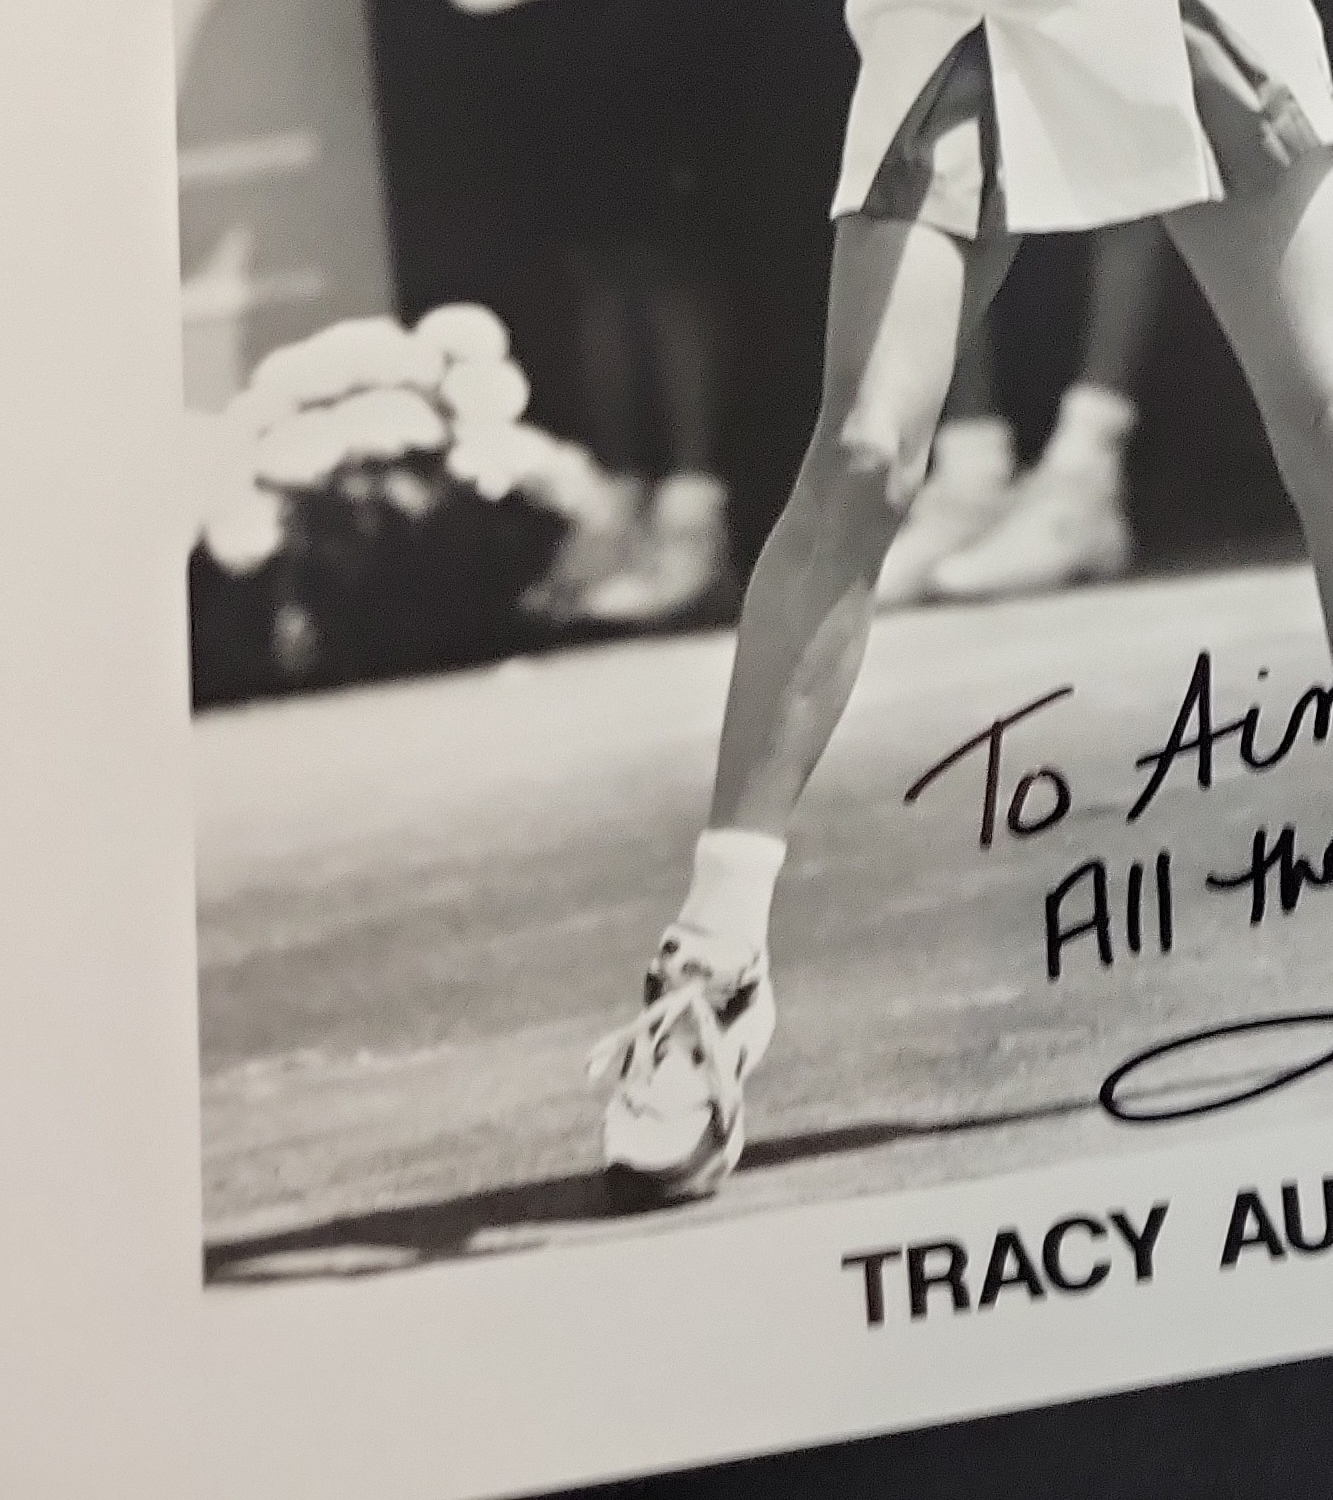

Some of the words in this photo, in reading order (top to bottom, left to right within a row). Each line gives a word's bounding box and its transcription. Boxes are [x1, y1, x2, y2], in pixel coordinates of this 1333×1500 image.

[904, 686, 1073, 848] To
[1044, 850, 1173, 982] All
[841, 1203, 1174, 1329] TRACY
